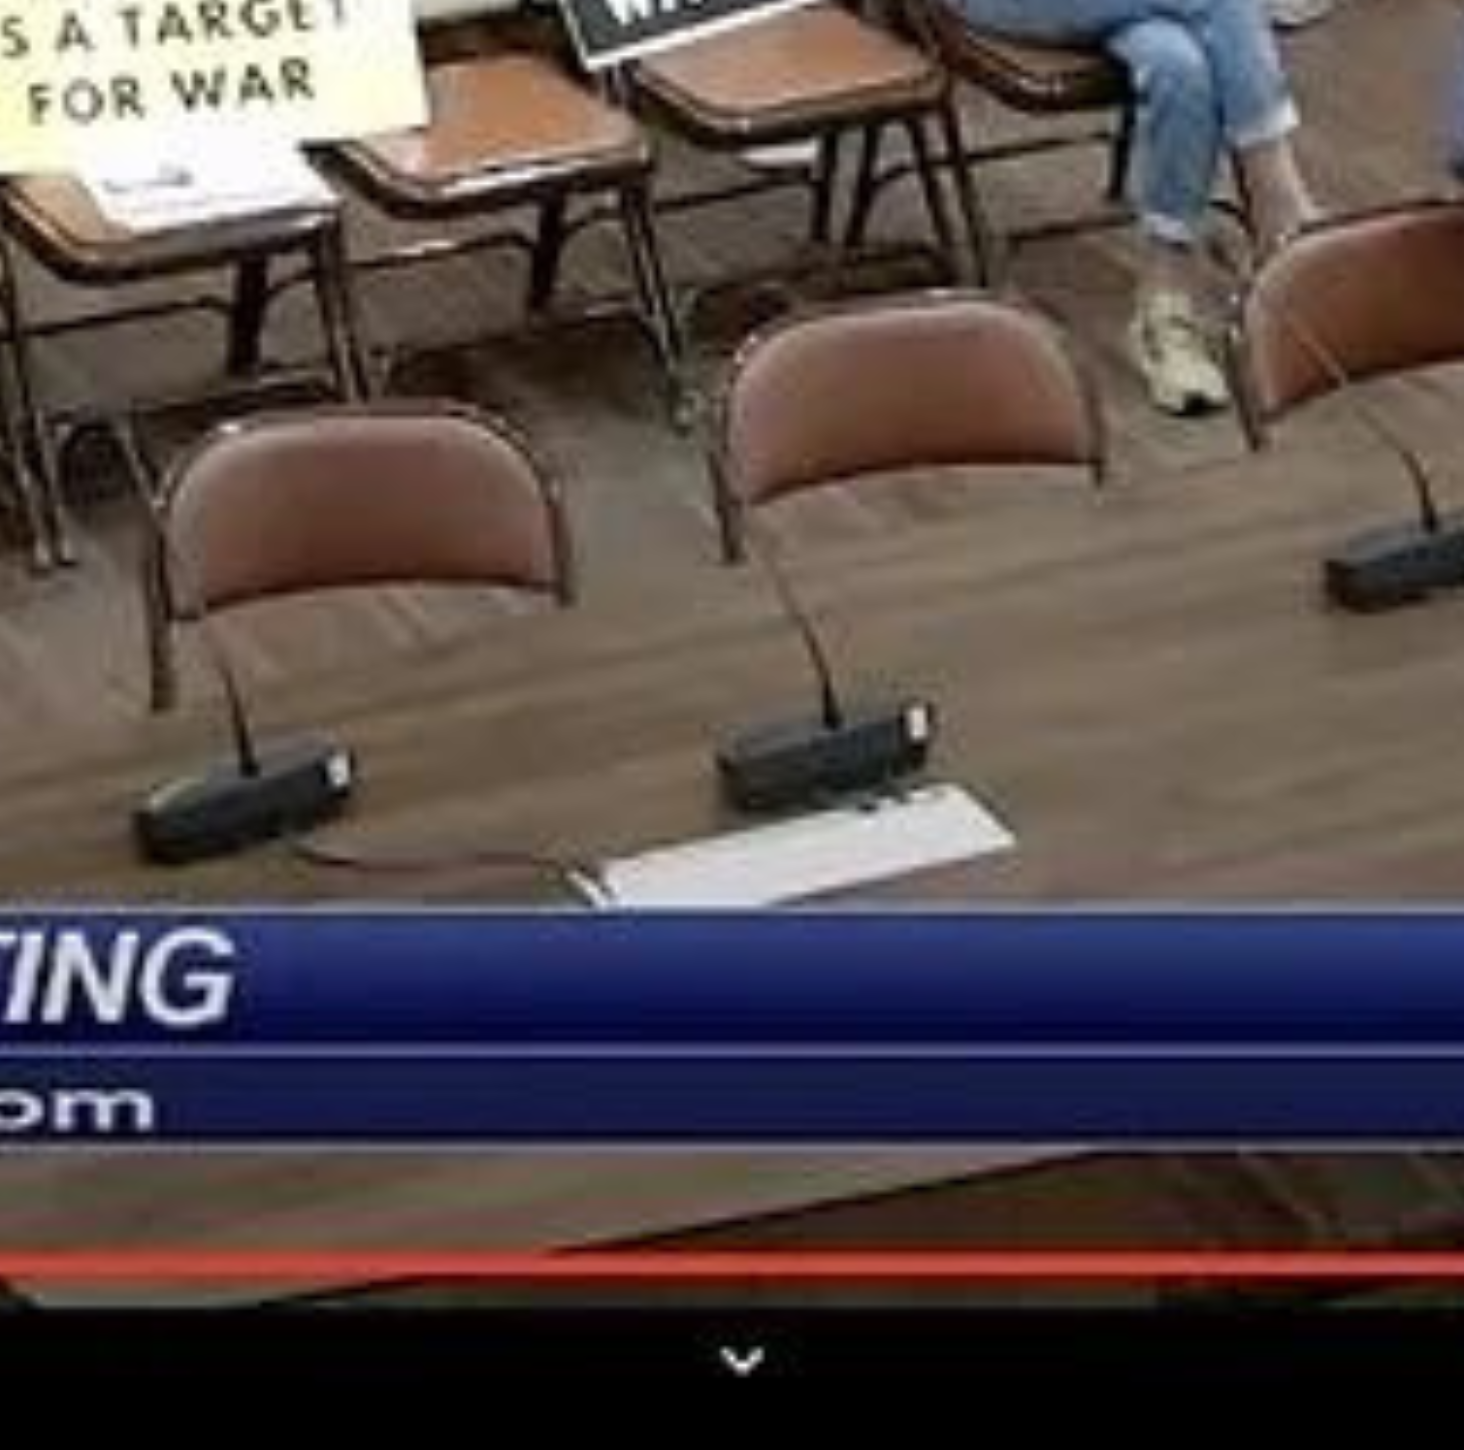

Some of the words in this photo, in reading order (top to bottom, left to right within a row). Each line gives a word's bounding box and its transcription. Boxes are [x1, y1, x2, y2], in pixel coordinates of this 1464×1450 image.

[54, 13, 94, 52] A
[25, 75, 147, 127] FOR
[169, 56, 316, 112] WAR
